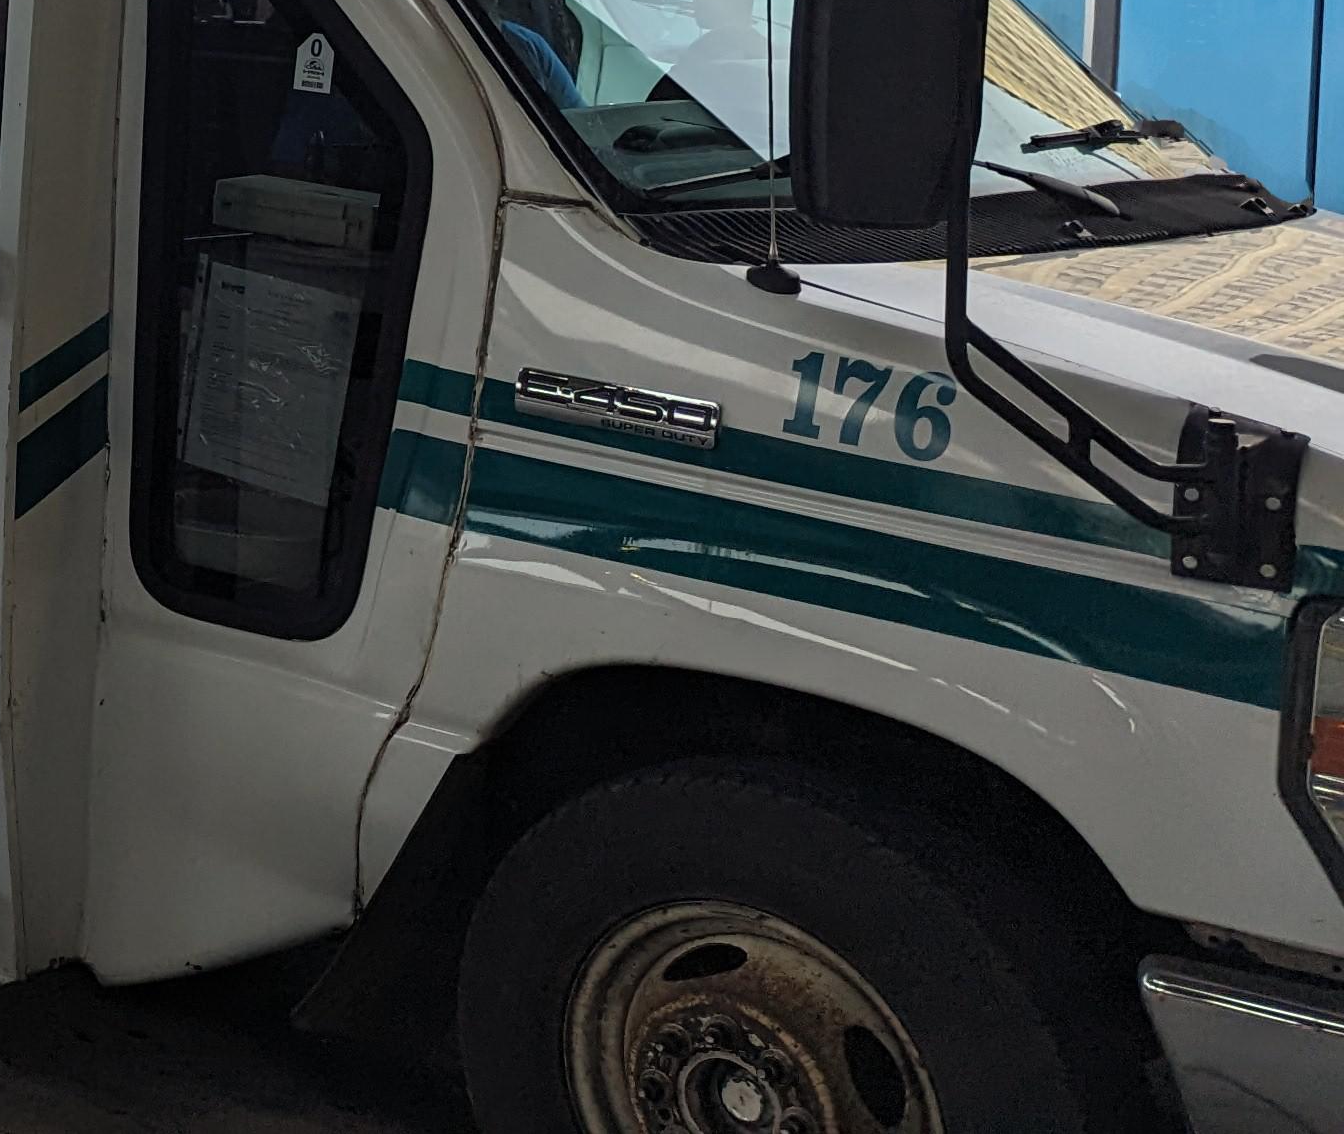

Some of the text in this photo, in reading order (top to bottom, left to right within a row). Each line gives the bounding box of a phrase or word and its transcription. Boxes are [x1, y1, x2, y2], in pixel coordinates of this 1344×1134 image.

[600, 418, 709, 446] SUPER DUTY
[781, 351, 958, 462] 176
